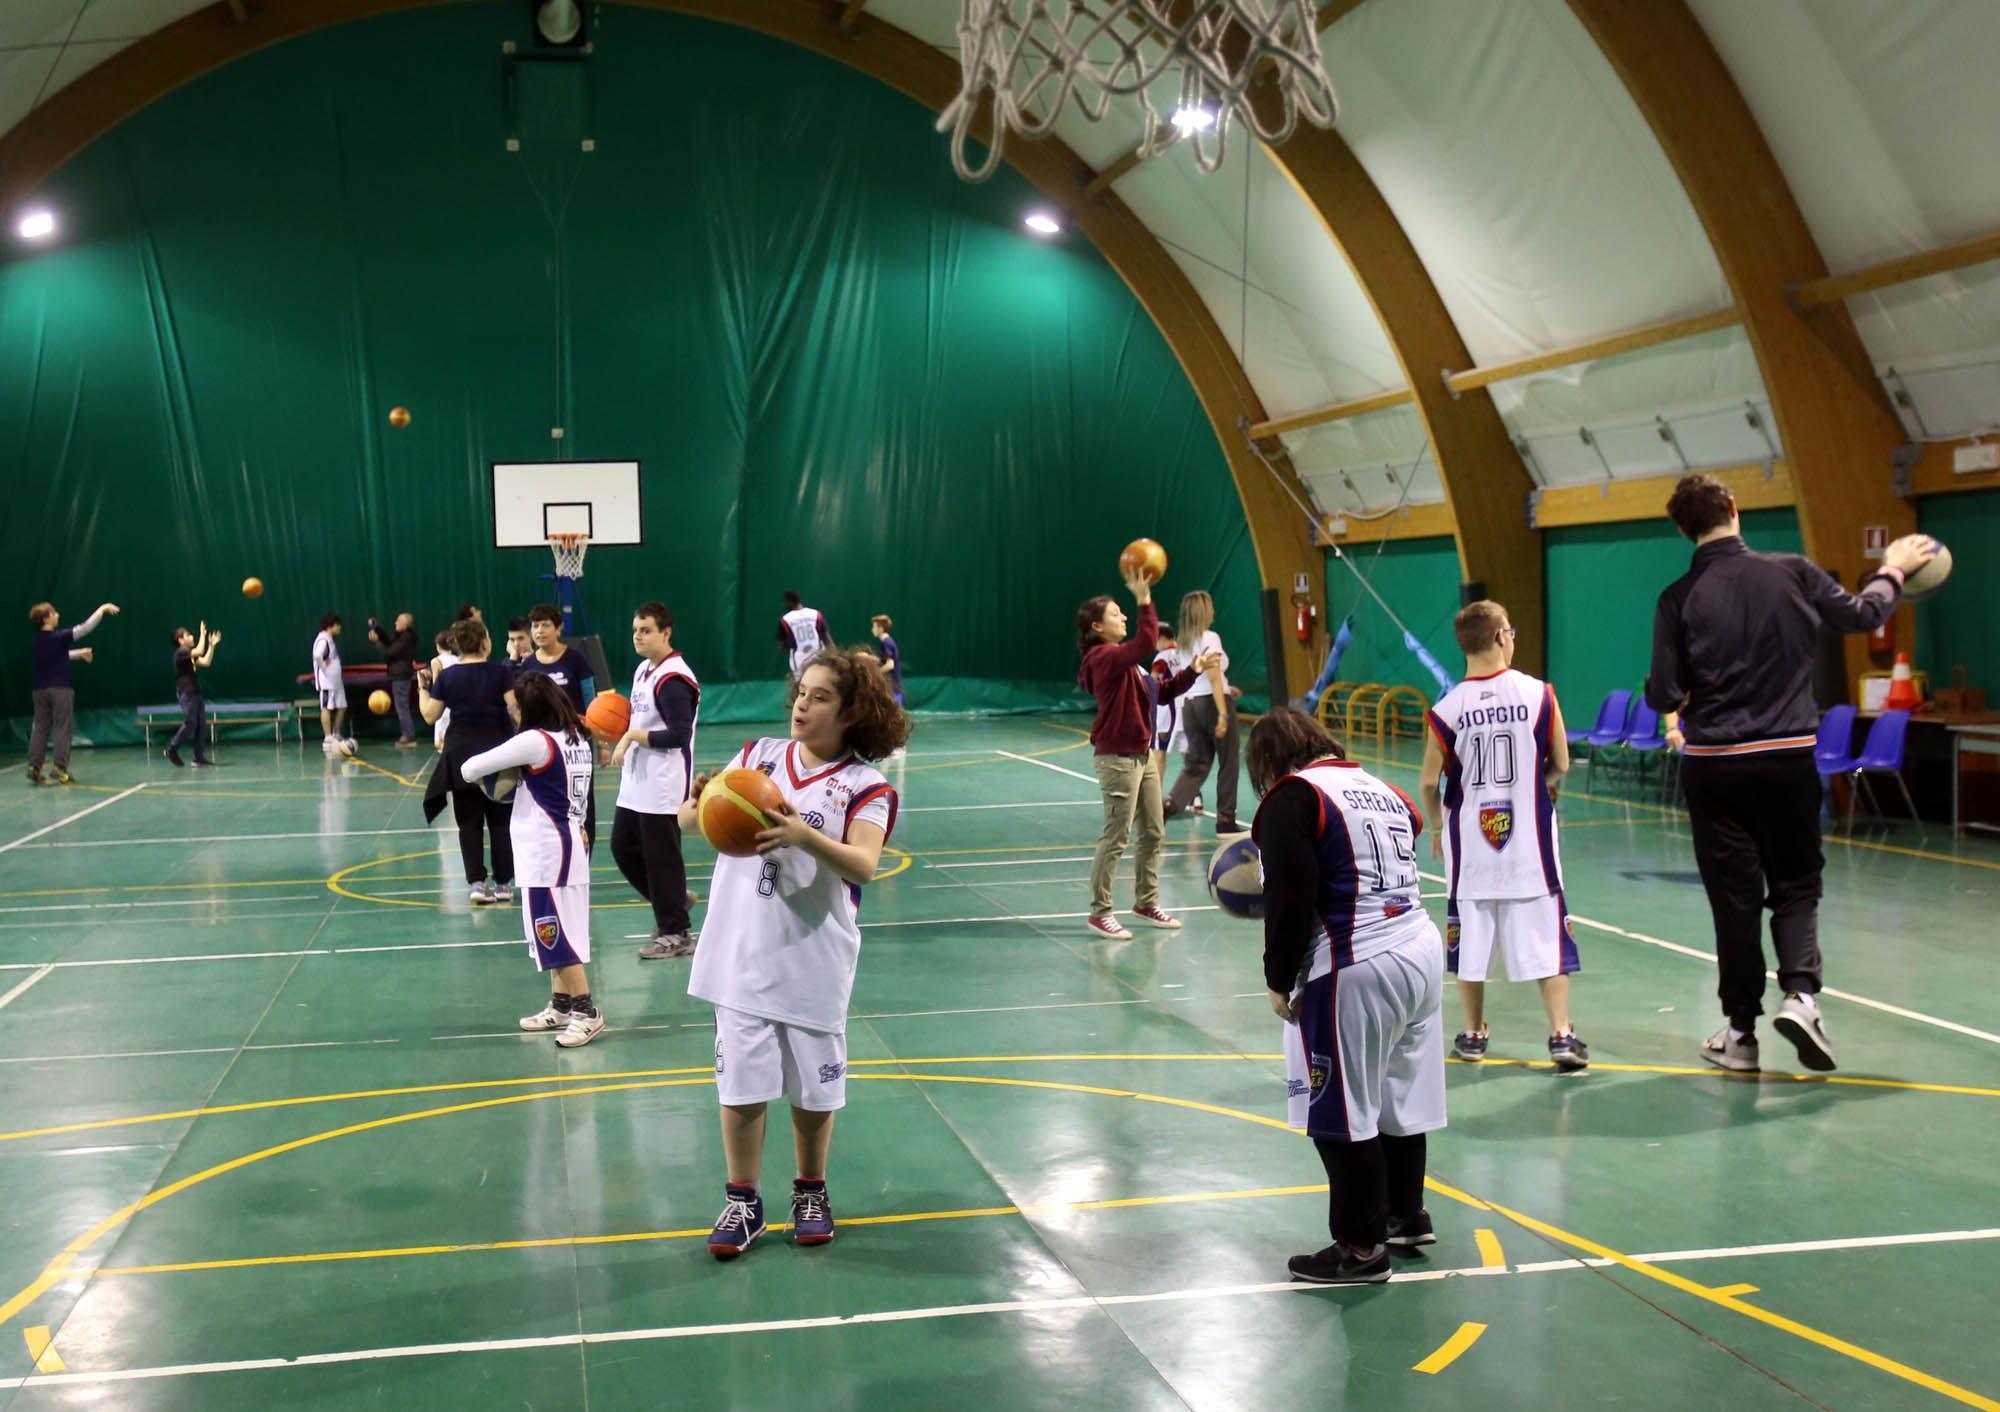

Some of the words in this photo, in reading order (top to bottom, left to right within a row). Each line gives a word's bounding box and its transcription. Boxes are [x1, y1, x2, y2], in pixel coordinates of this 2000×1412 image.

[1471, 731, 1518, 791] 10
[1343, 790, 1406, 817] SERENA
[757, 859, 780, 898] 8
[1363, 818, 1416, 892] 15
